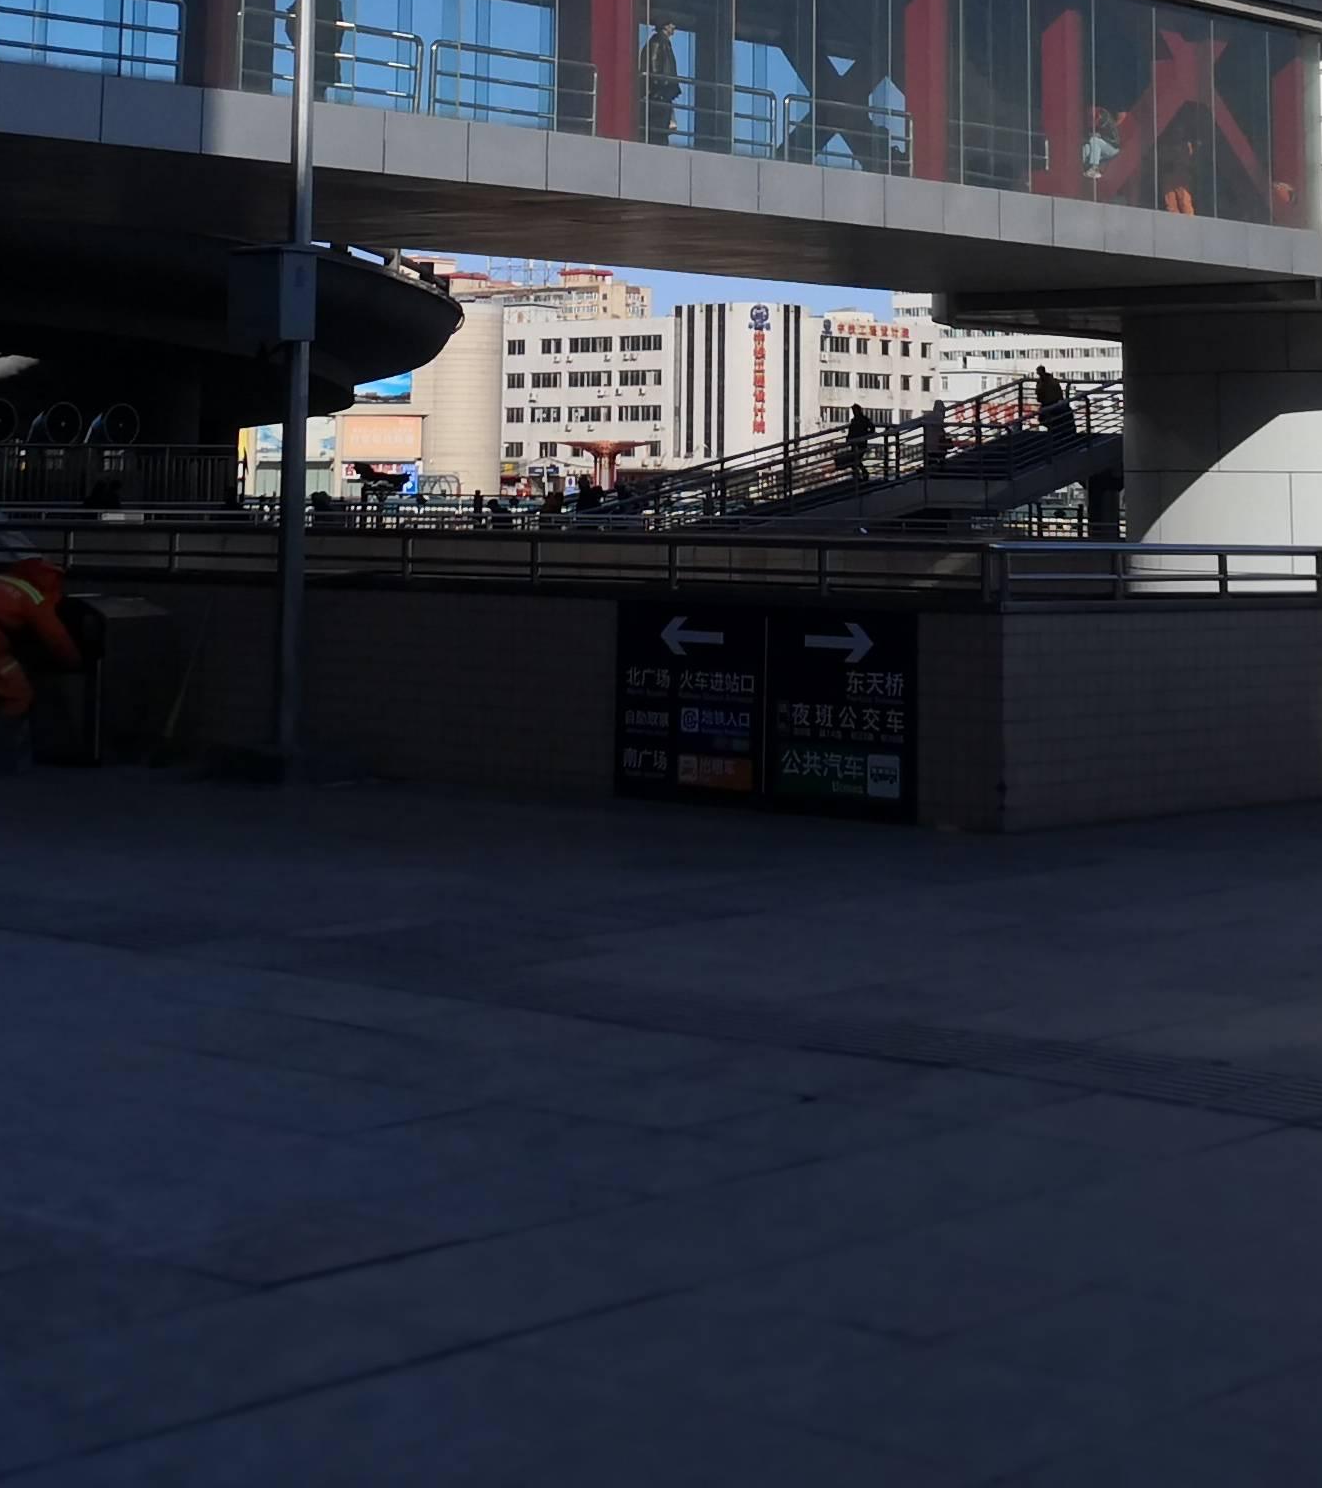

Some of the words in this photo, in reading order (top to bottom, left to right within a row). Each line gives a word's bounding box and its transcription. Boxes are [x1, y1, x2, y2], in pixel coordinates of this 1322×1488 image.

[626, 666, 671, 689] 北广场
[679, 669, 755, 694] 火车进站口
[846, 670, 905, 697] 东天桥
[791, 702, 906, 734] 夜班公交车
[622, 747, 668, 771] 南广场
[781, 749, 865, 779] 公共汽车
